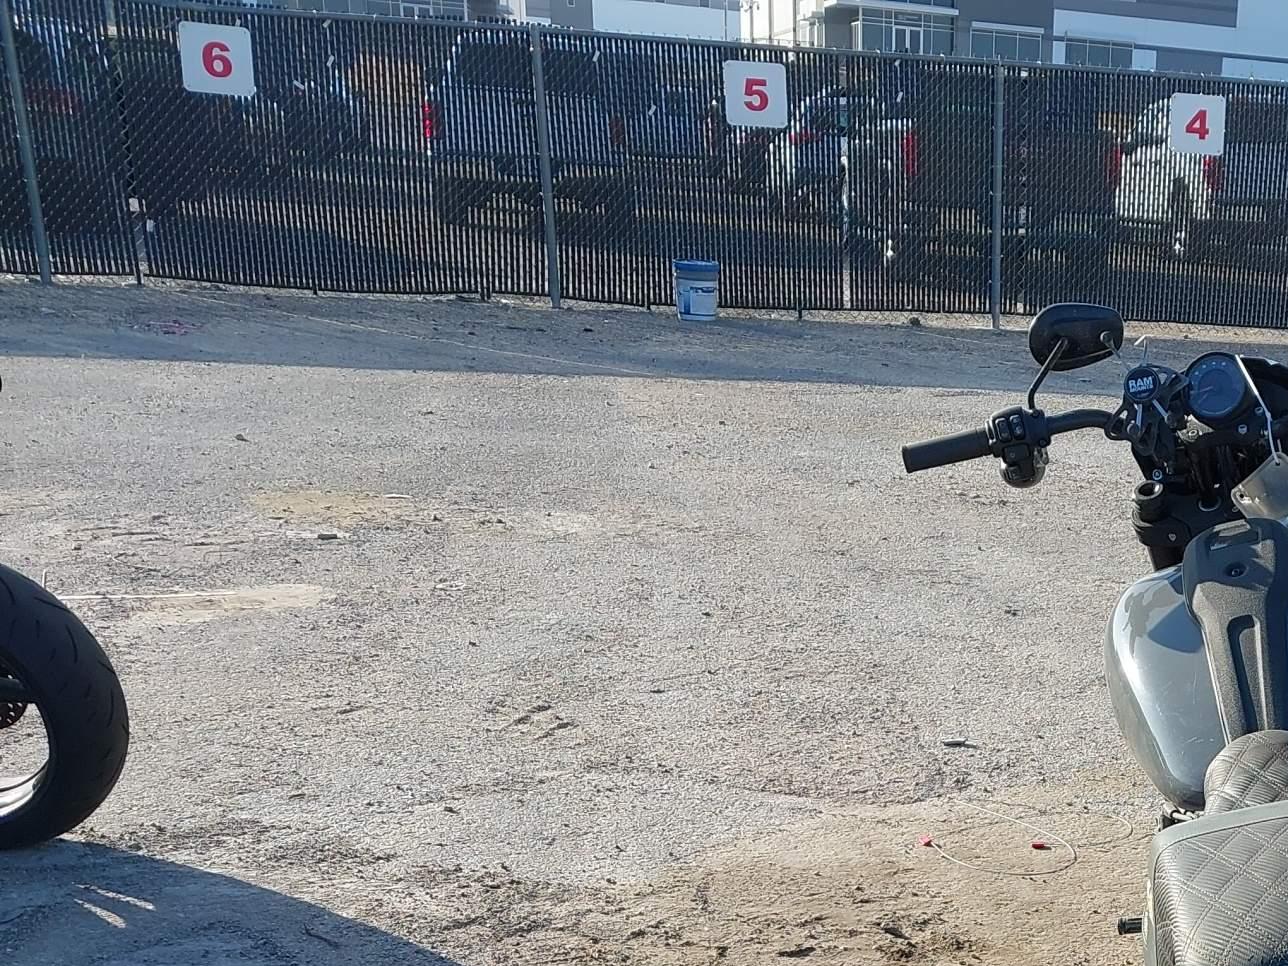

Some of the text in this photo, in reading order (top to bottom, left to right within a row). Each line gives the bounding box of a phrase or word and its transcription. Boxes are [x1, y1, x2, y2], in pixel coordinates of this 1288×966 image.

[202, 41, 233, 79] 6
[743, 77, 769, 112] 5
[1185, 109, 1209, 141] 4
[1128, 376, 1153, 387] RAM
